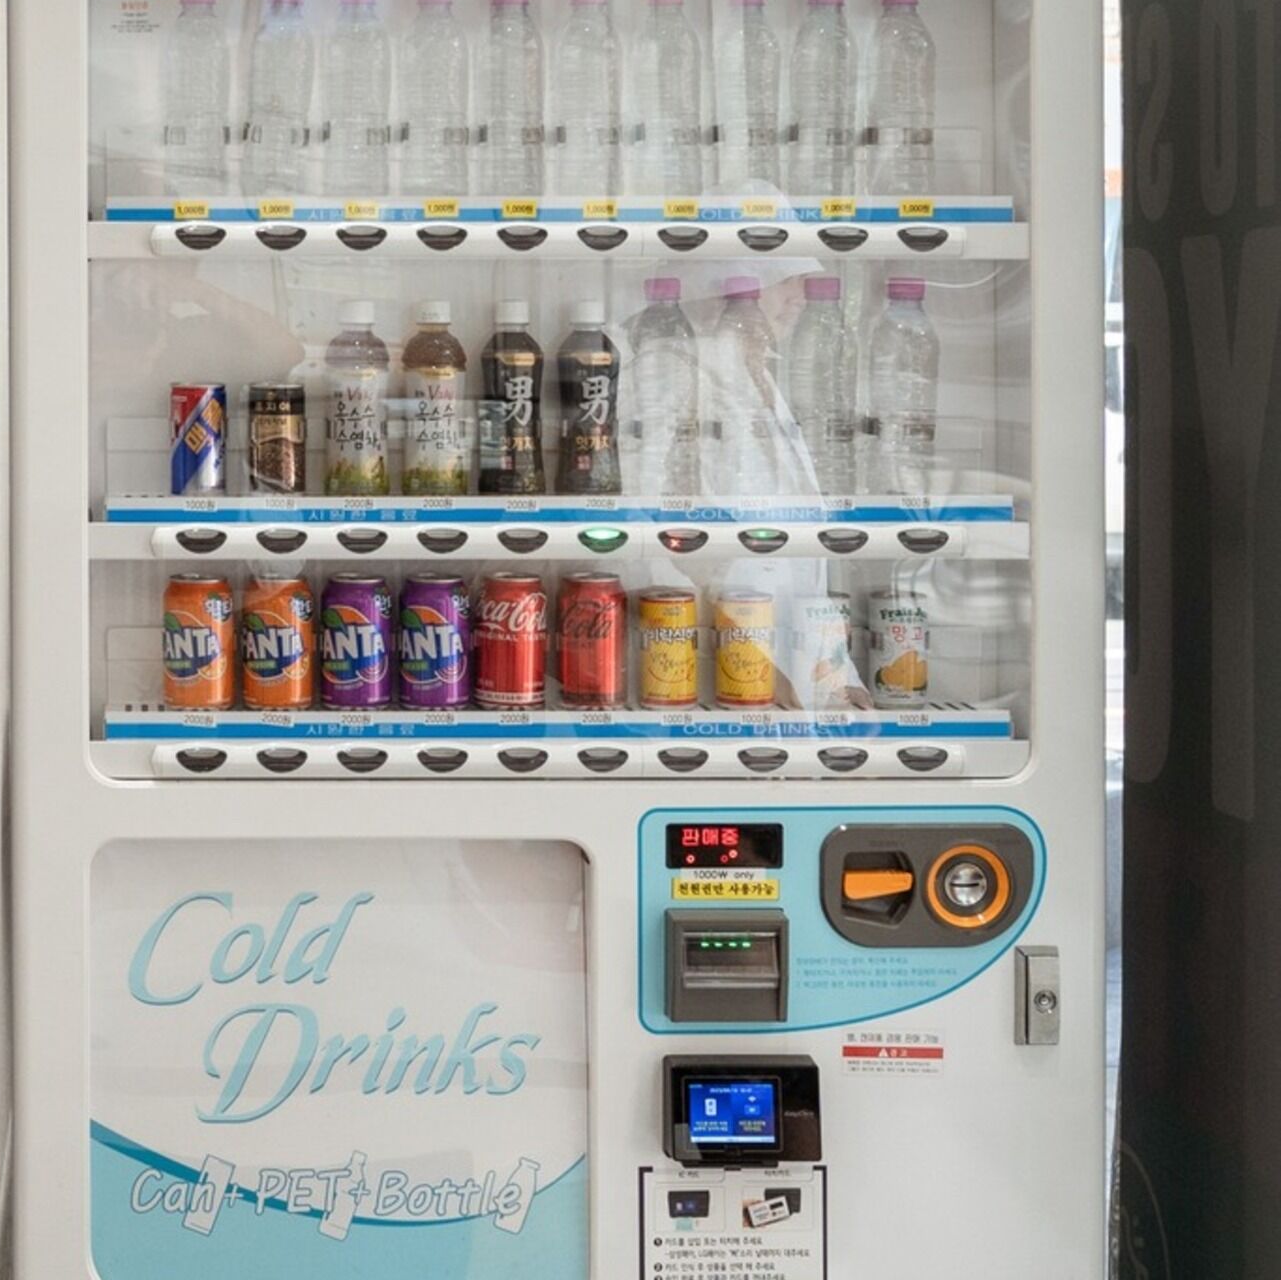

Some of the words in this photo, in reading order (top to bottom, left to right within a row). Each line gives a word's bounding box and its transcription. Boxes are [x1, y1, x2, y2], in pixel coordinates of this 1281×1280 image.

[334, 400, 375, 428] 옥수수
[415, 400, 455, 428] 옥수수
[504, 376, 534, 426] 男
[579, 375, 611, 425] 男
[686, 507, 748, 520] COLD
[164, 628, 221, 659] ANTA
[245, 627, 303, 659] ANTA
[323, 625, 385, 659] ANTA
[401, 625, 464, 659] ANTA
[501, 714, 530, 723] 2000원
[582, 714, 611, 723] 2000원
[663, 715, 692, 724] 1000원
[683, 723, 742, 735] COLD
[753, 723, 830, 735] DRINKS
[682, 828, 739, 846] 판매중
[734, 870, 754, 881] only
[127, 891, 375, 1006] Cold
[195, 1001, 541, 1124] Drinks
[130, 1167, 220, 1216] Can
[255, 1167, 352, 1216] PET
[374, 1167, 523, 1216] Bottle
